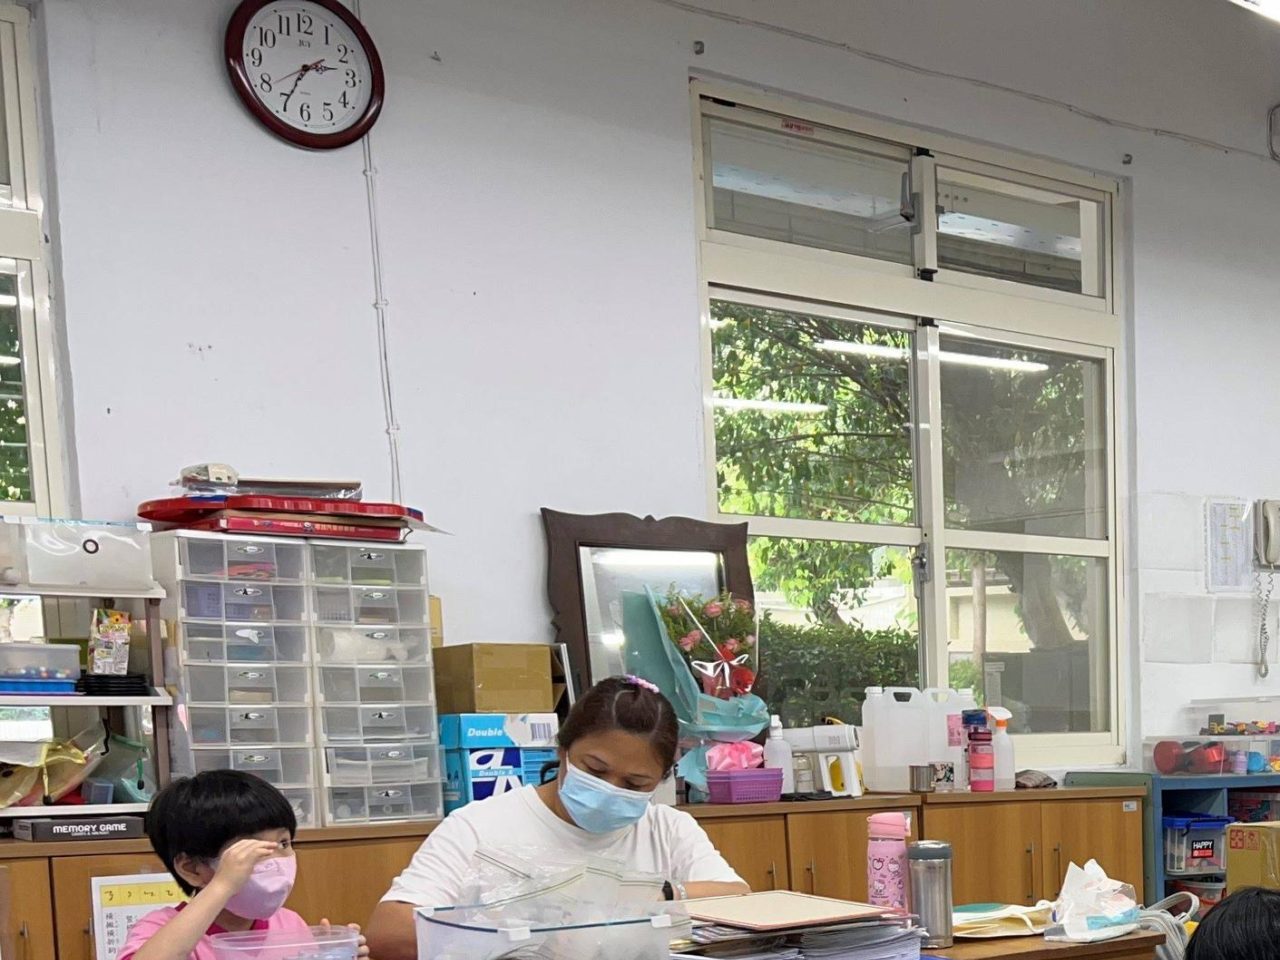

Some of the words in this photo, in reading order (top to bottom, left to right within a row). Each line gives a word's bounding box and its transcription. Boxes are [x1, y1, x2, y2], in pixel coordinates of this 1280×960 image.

[278, 14, 290, 36] 11
[297, 13, 313, 35] 12
[259, 27, 276, 48] 10
[324, 25, 329, 45] 1
[251, 48, 262, 67] 9
[338, 44, 348, 64] 2
[260, 73, 272, 93] 8
[345, 69, 356, 88] 3
[280, 92, 290, 112] 7
[338, 91, 349, 109] 4
[300, 103, 311, 122] 6
[322, 102, 334, 121] 5
[467, 728, 503, 737] Double
[53, 825, 96, 833] MEMORY
[100, 823, 126, 831] GAME
[1193, 841, 1213, 849] HAPPY
